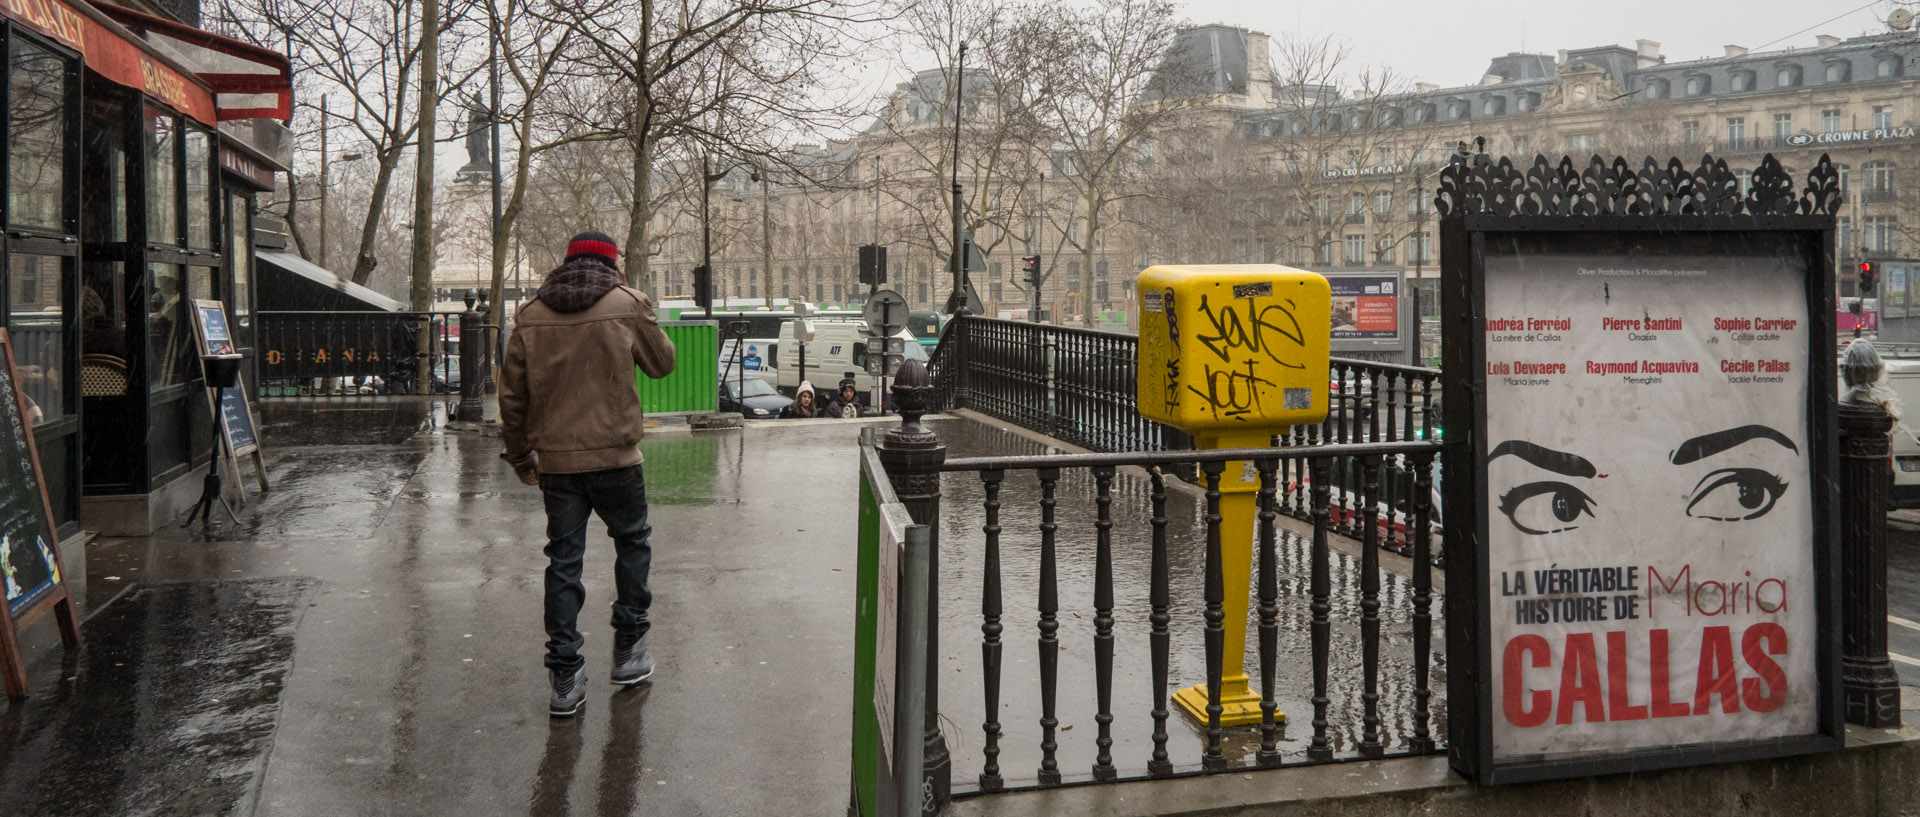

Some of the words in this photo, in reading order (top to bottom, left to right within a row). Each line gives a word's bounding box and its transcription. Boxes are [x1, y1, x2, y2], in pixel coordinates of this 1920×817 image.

[1817, 130, 1869, 143] CROWNE
[1875, 128, 1915, 139] PLAZA
[1342, 166, 1375, 177] CRONE
[1598, 267, 1634, 276] Productions
[1527, 316, 1571, 331] Ferréol
[1603, 317, 1641, 331] Pierre
[1644, 317, 1682, 331] Santini
[1714, 317, 1751, 332] Sophie
[1754, 317, 1797, 331] Carrier
[1492, 333, 1502, 342] La
[1524, 333, 1535, 342] de
[1536, 333, 1561, 342] Callas
[1628, 332, 1657, 341] Onassis
[1731, 332, 1755, 341] Callas
[1756, 333, 1780, 341] adulte
[268, 347, 380, 365] DANA
[830, 346, 842, 355] ATF
[1487, 361, 1510, 375] Lola
[1514, 361, 1566, 375] Dewaere
[1586, 360, 1638, 376] Raymond
[1641, 359, 1699, 375] Acquaviva
[1720, 358, 1755, 373] Cécile
[1757, 359, 1790, 373] Pallas
[1503, 377, 1527, 386] Maria
[1528, 378, 1550, 387] jeune
[1623, 376, 1662, 385] Meneghini
[1753, 375, 1784, 384] Kennedy
[1502, 571, 1527, 596] LA
[1534, 563, 1639, 595] VÉRITABLE
[1648, 564, 1787, 618] Maria
[1516, 596, 1608, 625] HISTOIRE
[1614, 595, 1639, 620] DE
[1502, 622, 1788, 728] CALLAS
